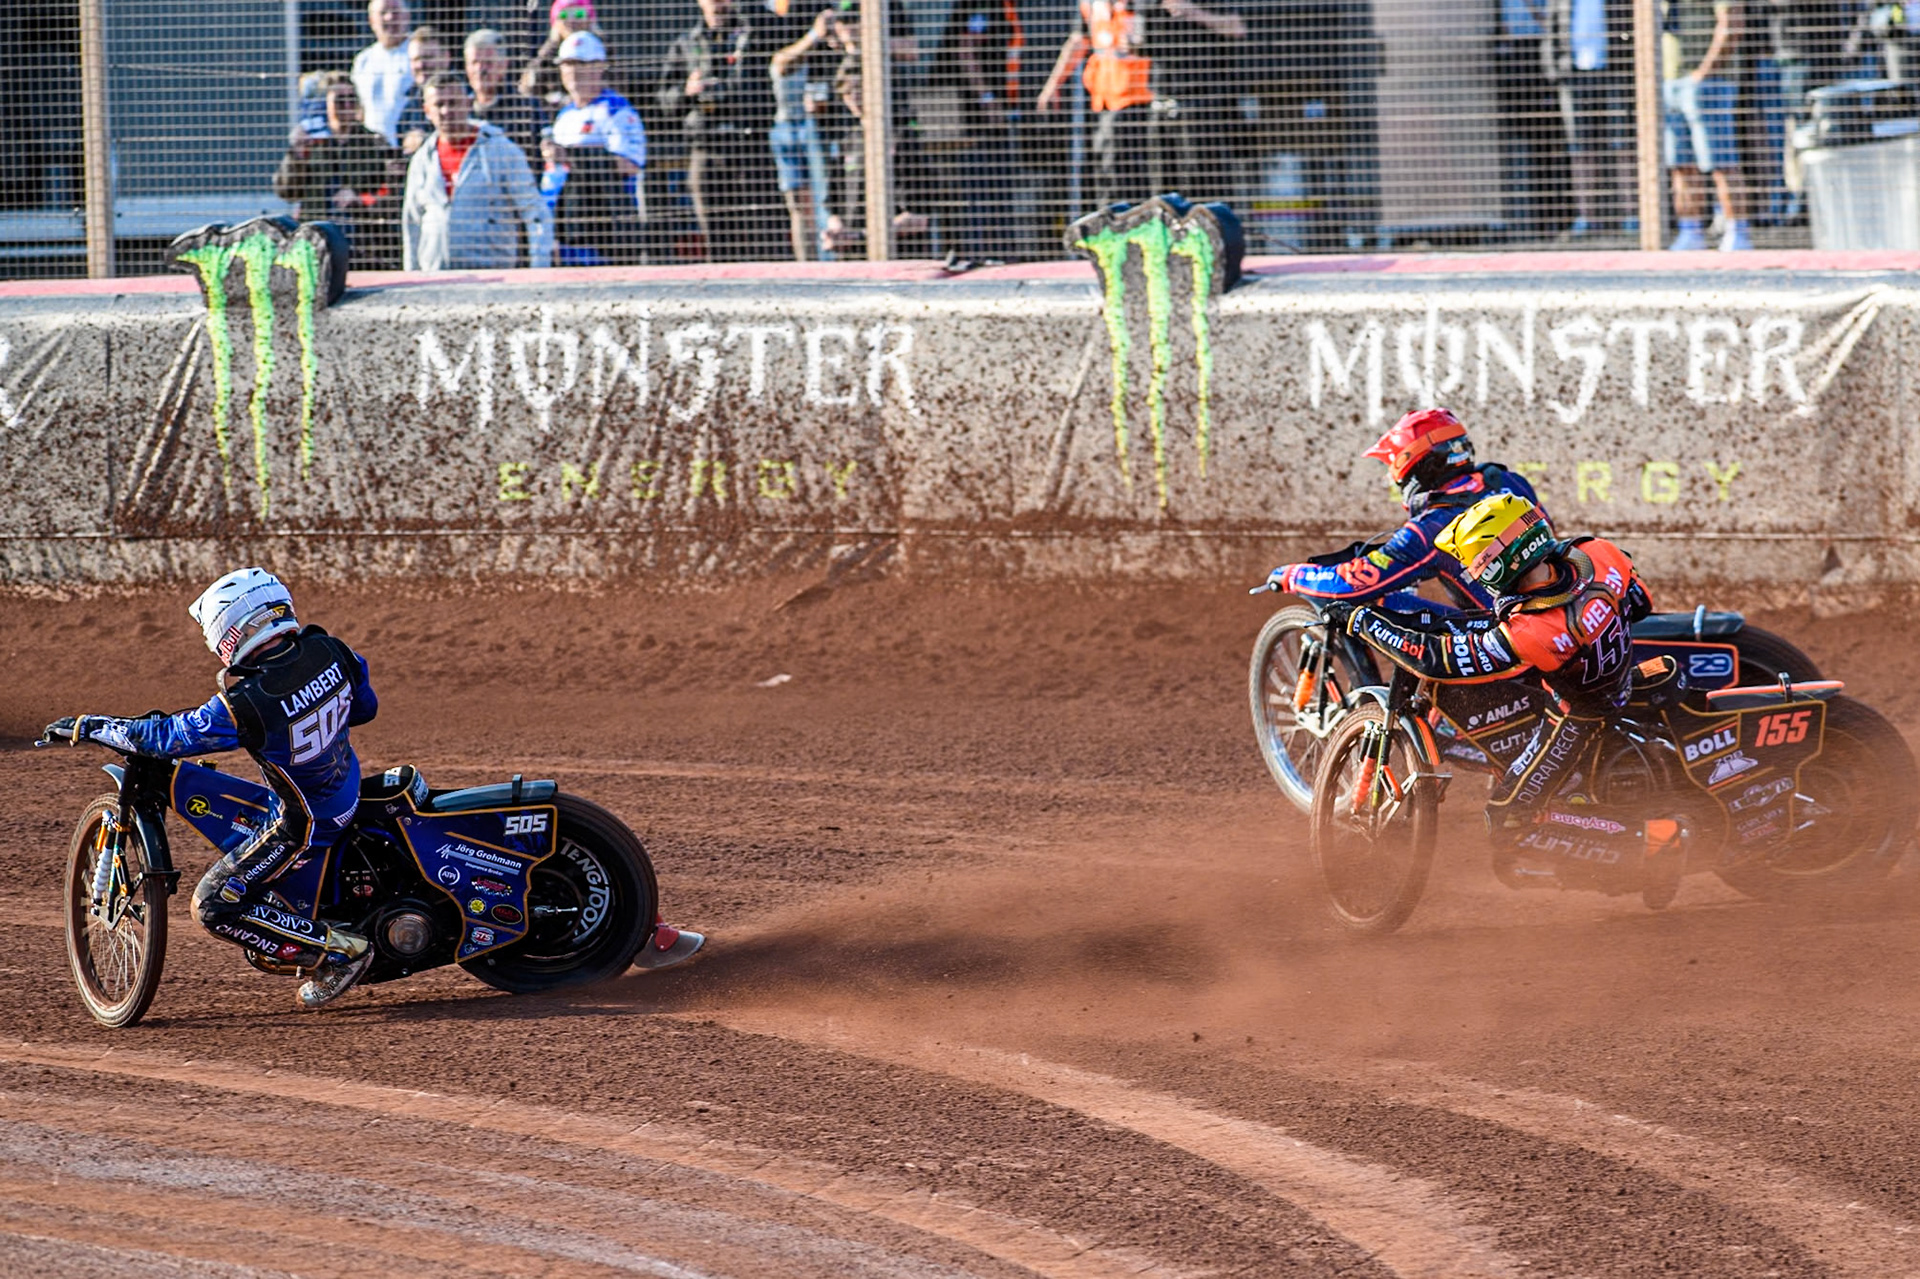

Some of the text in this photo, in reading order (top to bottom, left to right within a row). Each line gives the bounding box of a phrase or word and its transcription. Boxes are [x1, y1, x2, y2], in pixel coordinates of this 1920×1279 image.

[417, 304, 921, 431] MONSTER
[1307, 304, 1817, 425] MONSTER
[1521, 533, 1548, 560] BOLL
[1368, 619, 1426, 660] Furnisol
[280, 662, 343, 718] LAMBERT
[1485, 696, 1530, 724] ANLAS
[289, 682, 353, 765] 505
[1550, 721, 1581, 761] RECK
[1755, 710, 1812, 748] 155
[1684, 730, 1736, 762] BOLL
[504, 813, 548, 835] 505
[242, 843, 286, 884] Teletecnica
[455, 844, 522, 869] Jörg Grohmann
